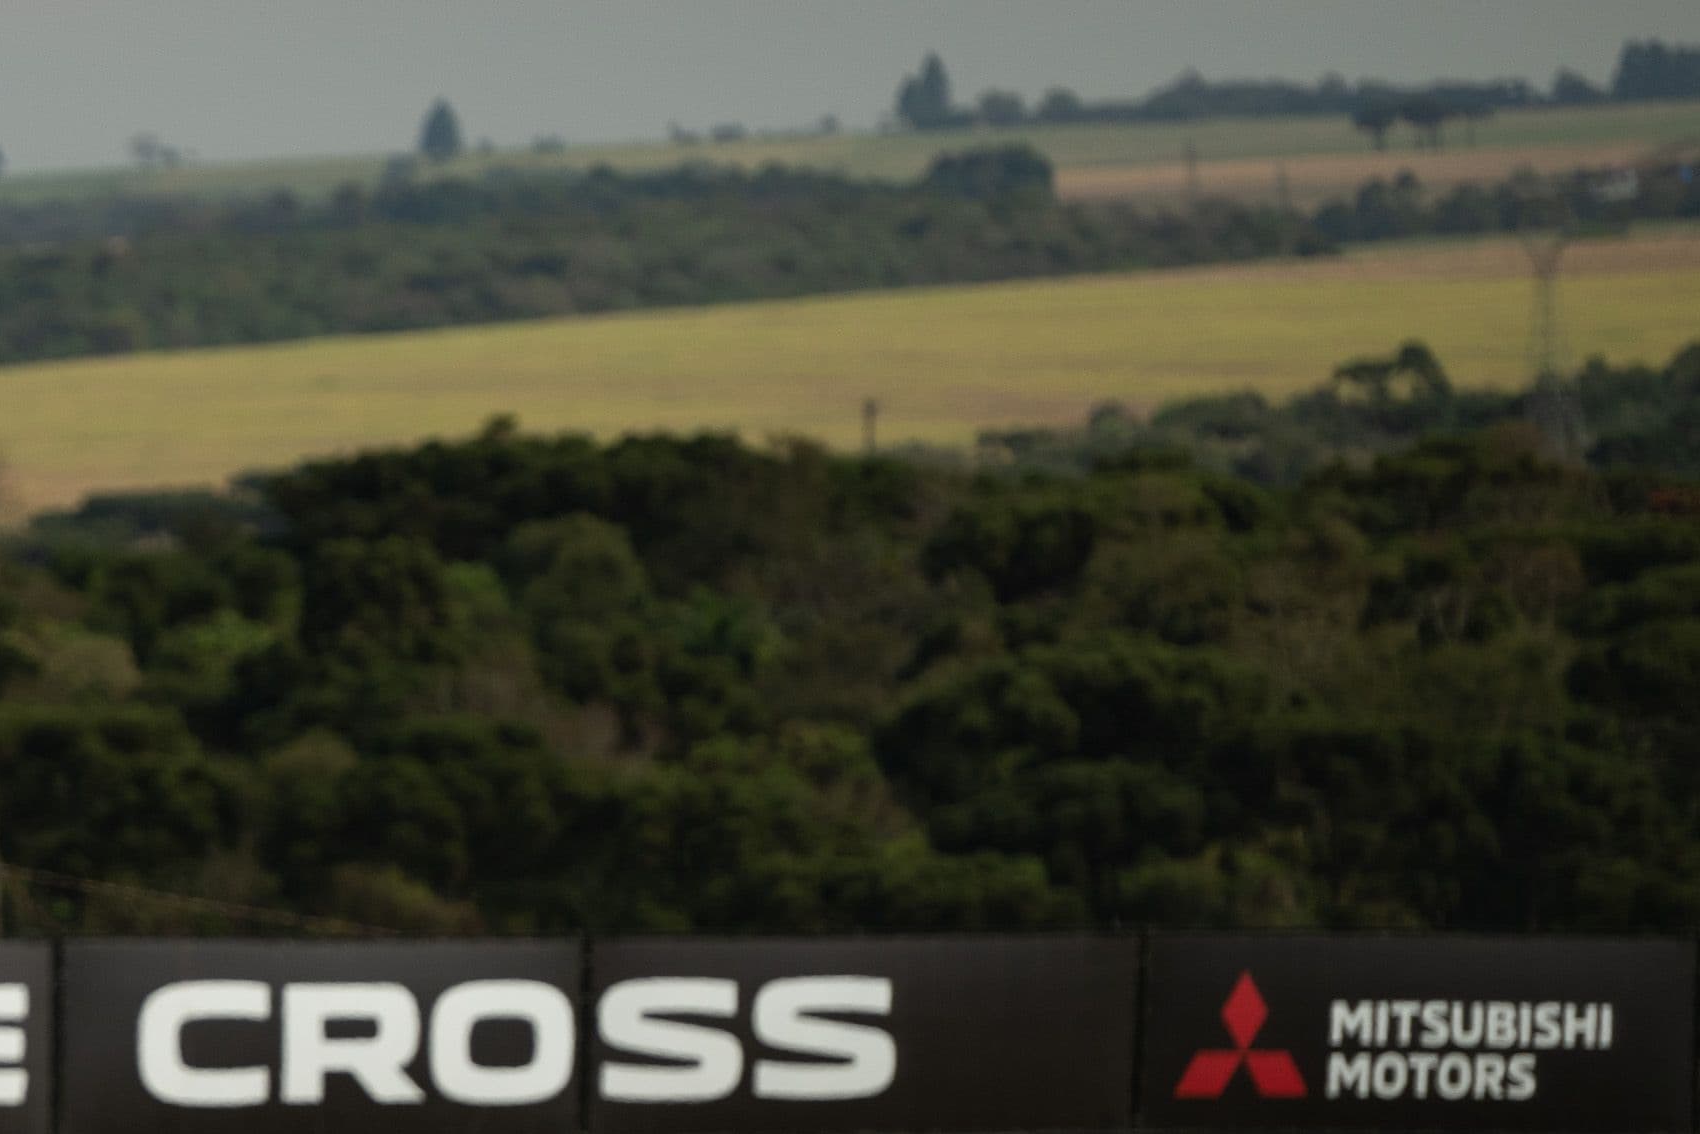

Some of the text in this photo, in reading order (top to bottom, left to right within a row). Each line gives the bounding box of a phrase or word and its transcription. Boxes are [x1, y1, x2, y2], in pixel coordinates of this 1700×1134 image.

[136, 975, 897, 1107] CROSS
[1328, 1000, 1612, 1050] MITSUBISHI
[1325, 1053, 1537, 1100] MOTORS
